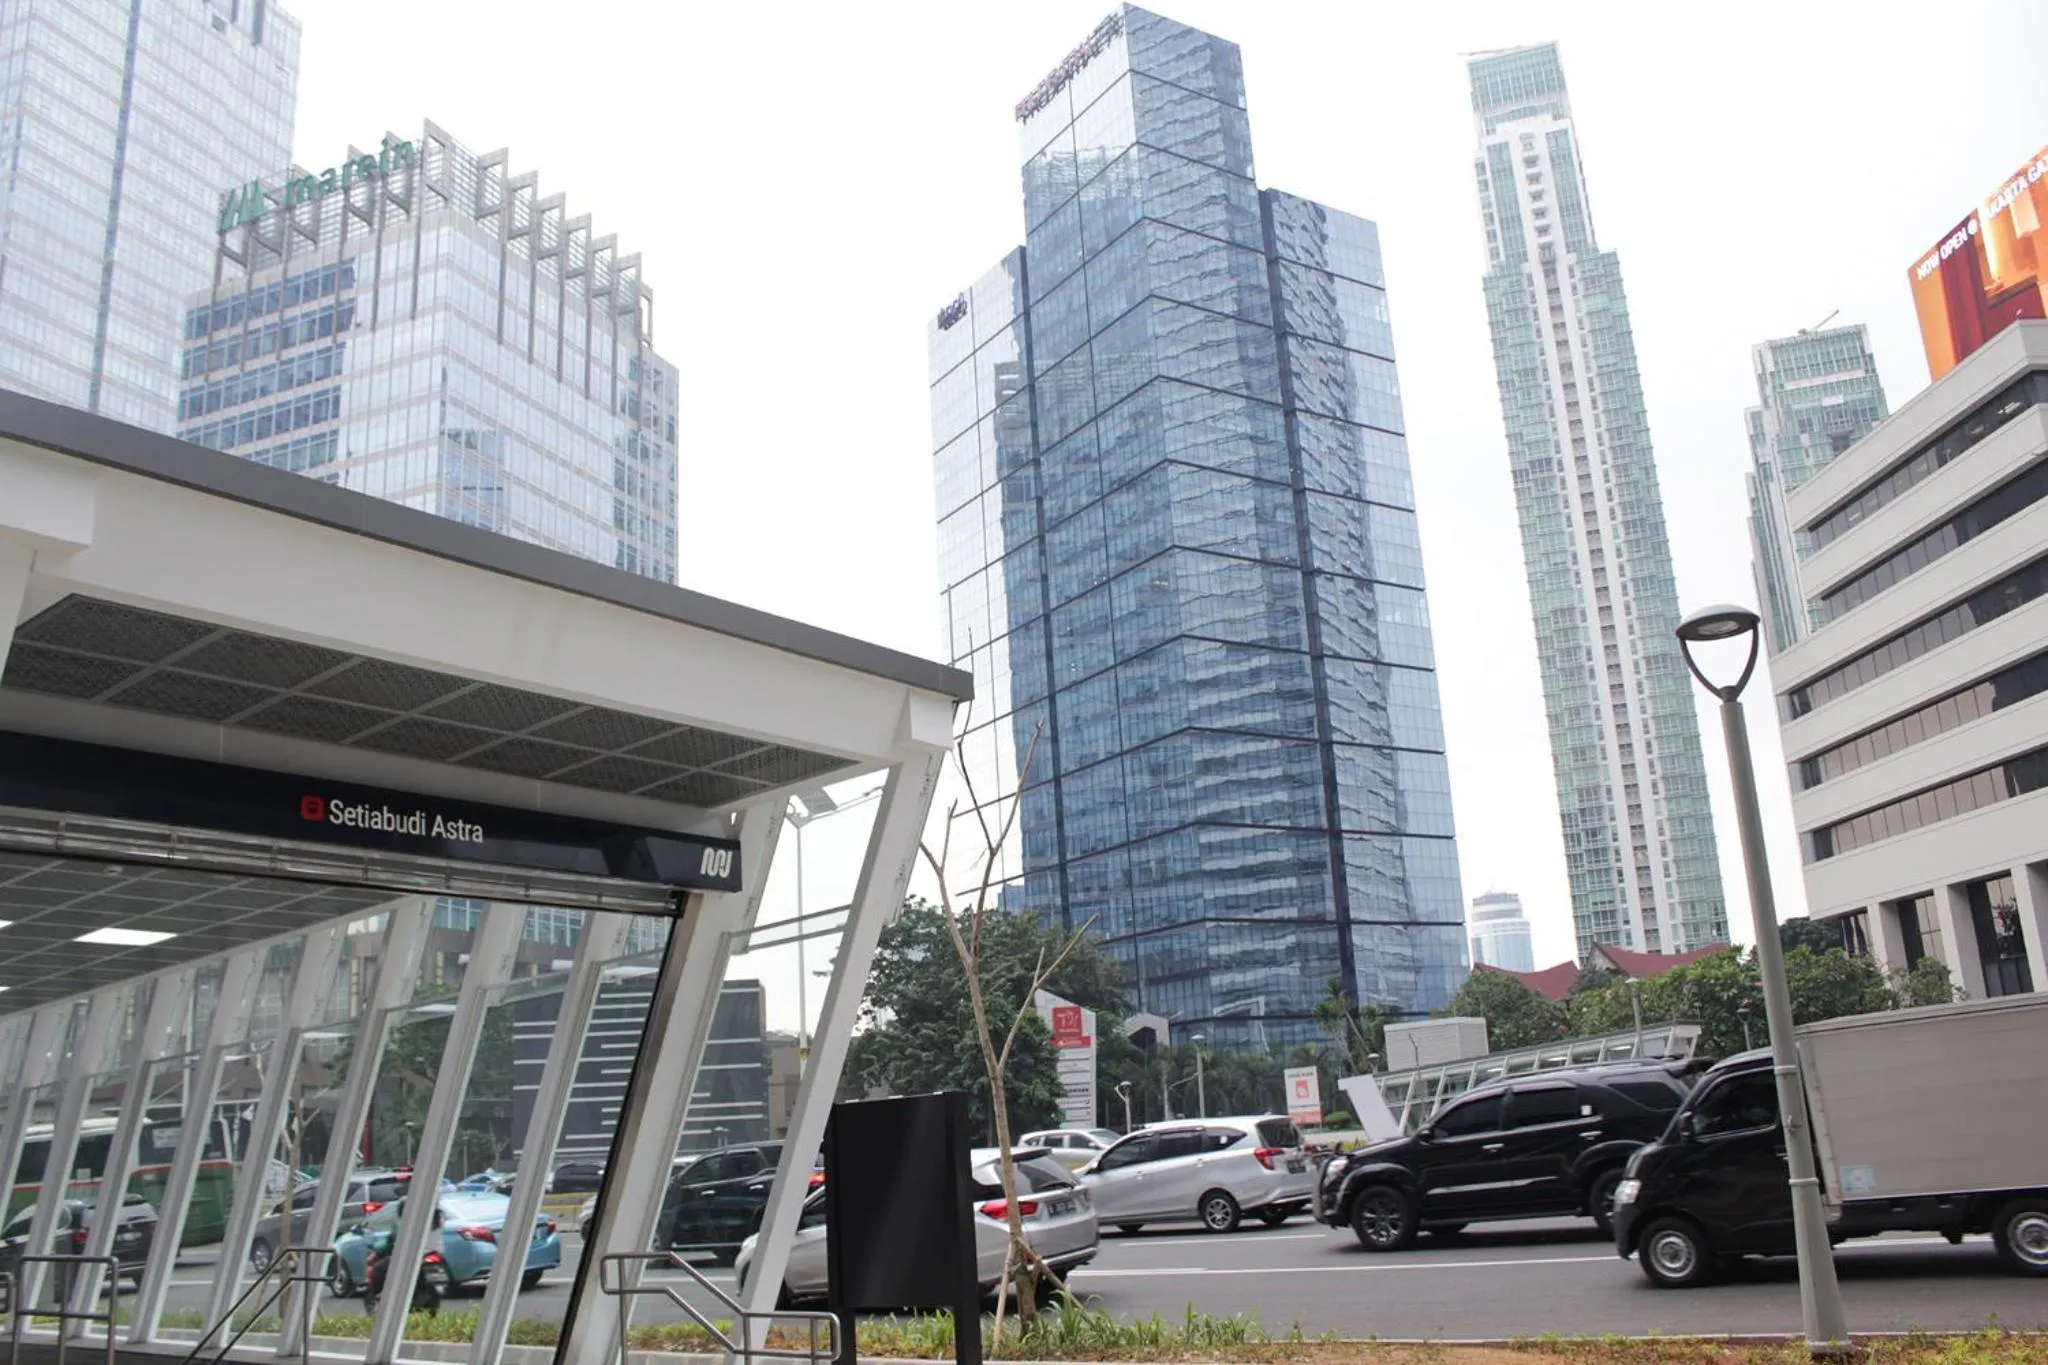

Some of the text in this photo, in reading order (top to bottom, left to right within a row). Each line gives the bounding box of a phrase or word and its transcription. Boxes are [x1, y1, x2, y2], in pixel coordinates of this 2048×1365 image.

[1915, 250, 1940, 281] NOW
[1940, 227, 1968, 260] OPEN
[329, 799, 483, 844] Setiabudi Astra
